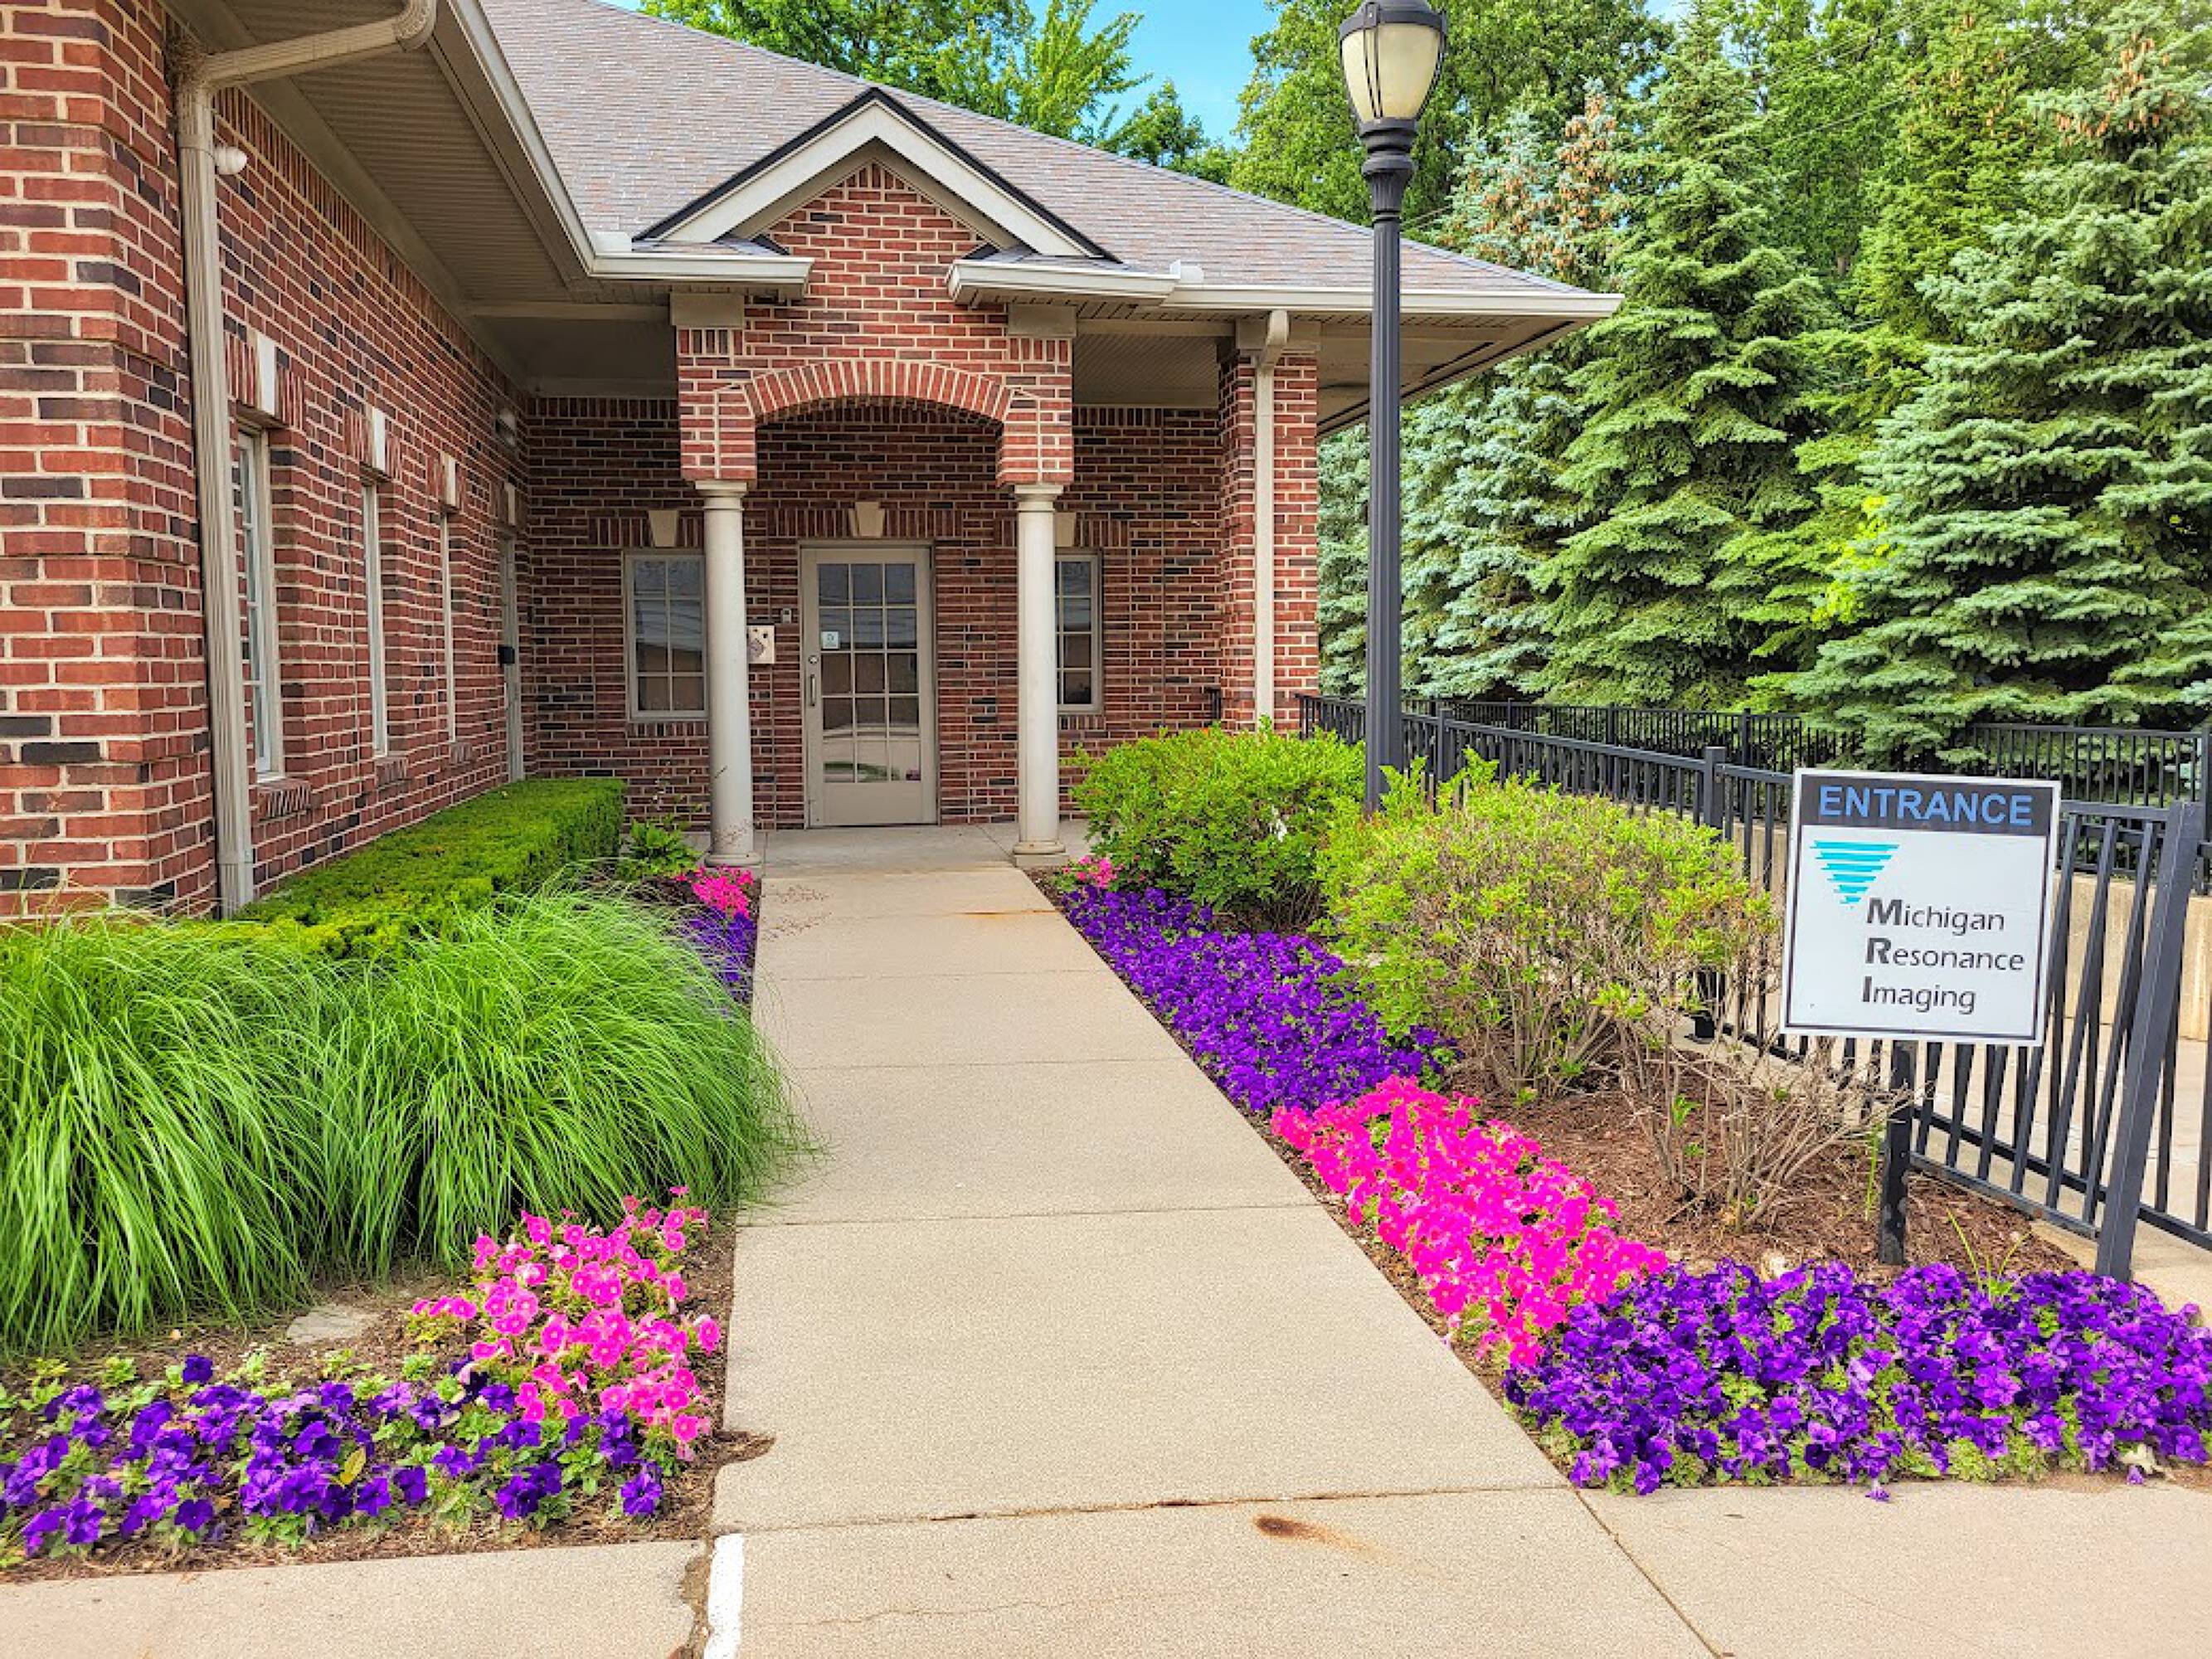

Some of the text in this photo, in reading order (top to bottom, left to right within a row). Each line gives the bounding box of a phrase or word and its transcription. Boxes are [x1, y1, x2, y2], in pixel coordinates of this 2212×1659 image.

[1819, 785, 2033, 825] ENTRANCE
[1866, 898, 2005, 937] Michigan
[1864, 937, 2025, 971] Resonance
[1862, 975, 1976, 1014] Imaging
